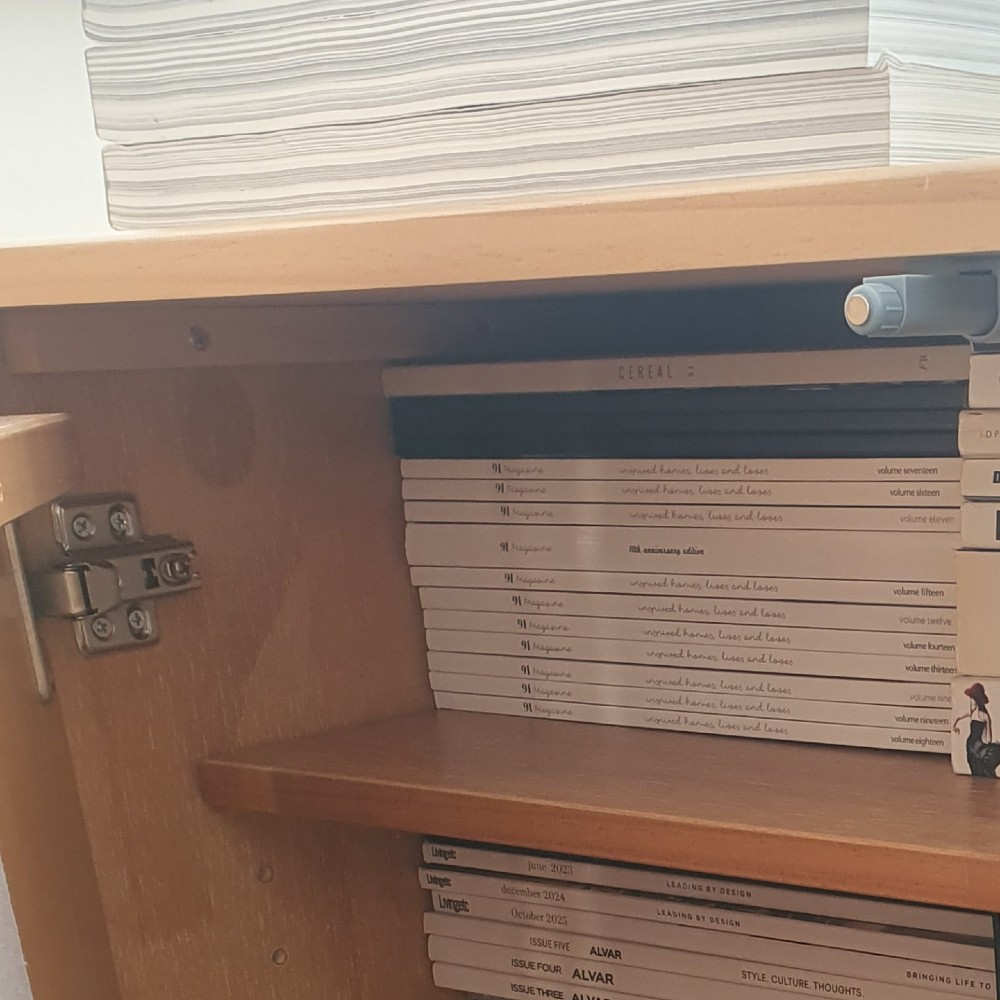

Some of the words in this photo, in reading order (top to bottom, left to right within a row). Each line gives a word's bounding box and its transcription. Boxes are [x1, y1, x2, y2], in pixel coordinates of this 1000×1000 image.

[877, 465, 902, 475] volume
[894, 587, 919, 596] volume
[921, 587, 944, 597] fifteen
[905, 664, 930, 672] volume
[931, 664, 957, 674] thirteen
[501, 884, 541, 899] december
[543, 890, 565, 902] 2024
[667, 881, 703, 892] LEADING
[720, 888, 751, 898] DESIGN
[511, 907, 544, 922] October
[546, 913, 567, 926] 2025
[657, 909, 692, 920] LEADING
[709, 917, 740, 927] DESIGN
[530, 937, 552, 949] ISSUE
[554, 941, 570, 951] FIVE
[590, 946, 622, 960] ALVAR
[511, 958, 536, 970] ISSUE
[537, 962, 562, 974] FOUR
[572, 968, 614, 985] ALVAR
[907, 971, 951, 984] BRINGING
[955, 978, 975, 988] LIFE
[980, 982, 991, 990] TO
[511, 983, 536, 995] ISSUE
[536, 988, 564, 1000] THREE
[812, 981, 861, 997] THOUGHTS.
